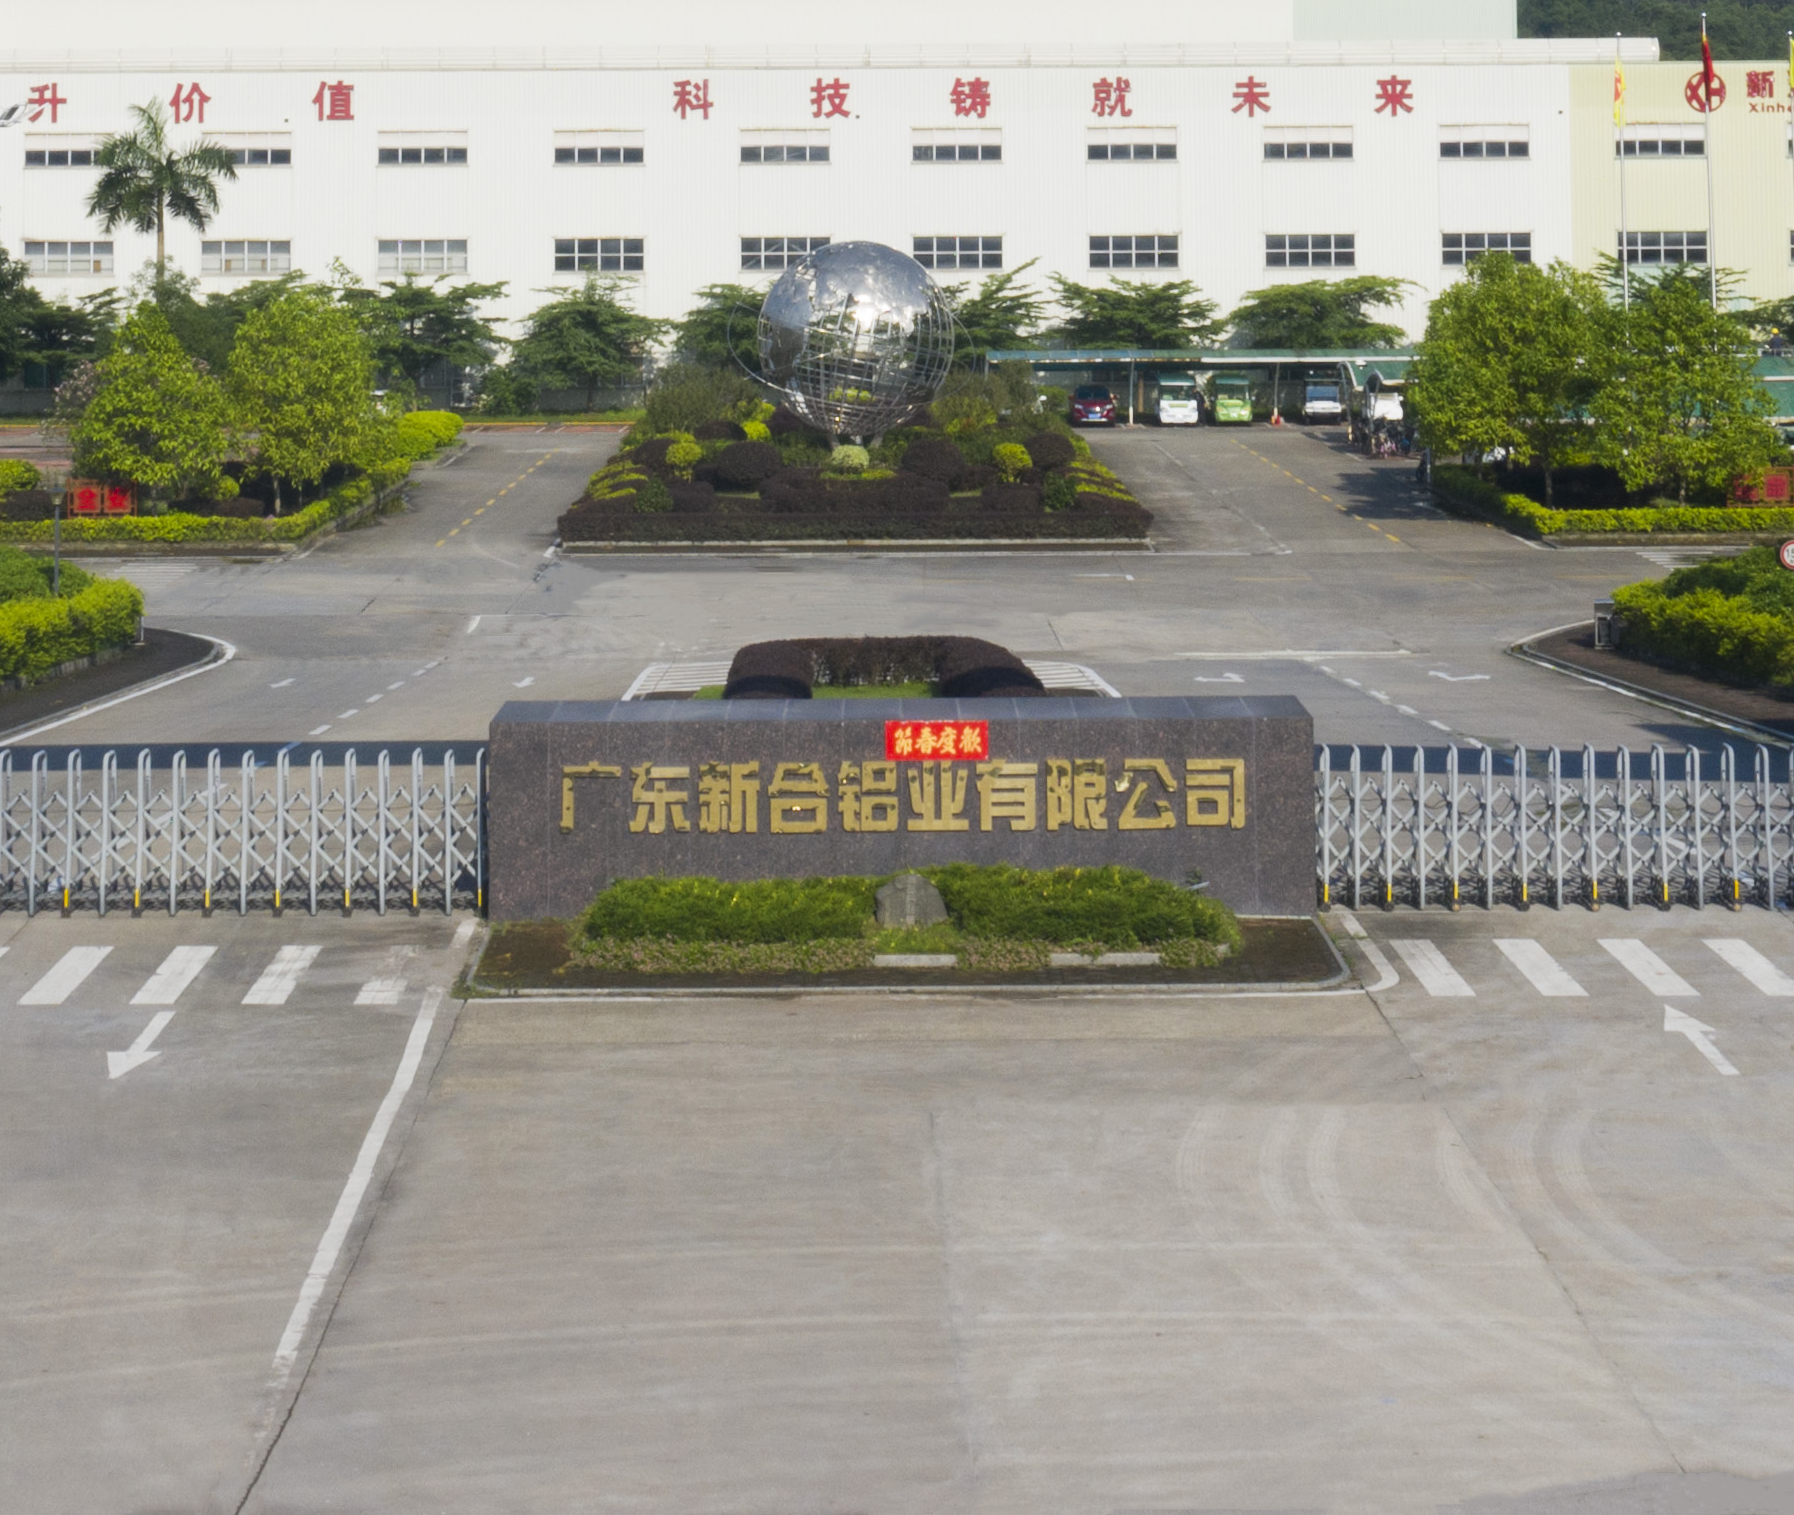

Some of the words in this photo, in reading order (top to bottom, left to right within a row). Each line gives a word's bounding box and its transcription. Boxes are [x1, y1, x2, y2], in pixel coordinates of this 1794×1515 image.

[674, 76, 1414, 120] 科技铸就未来
[560, 757, 1246, 833] 广东新合铝业有限公司
